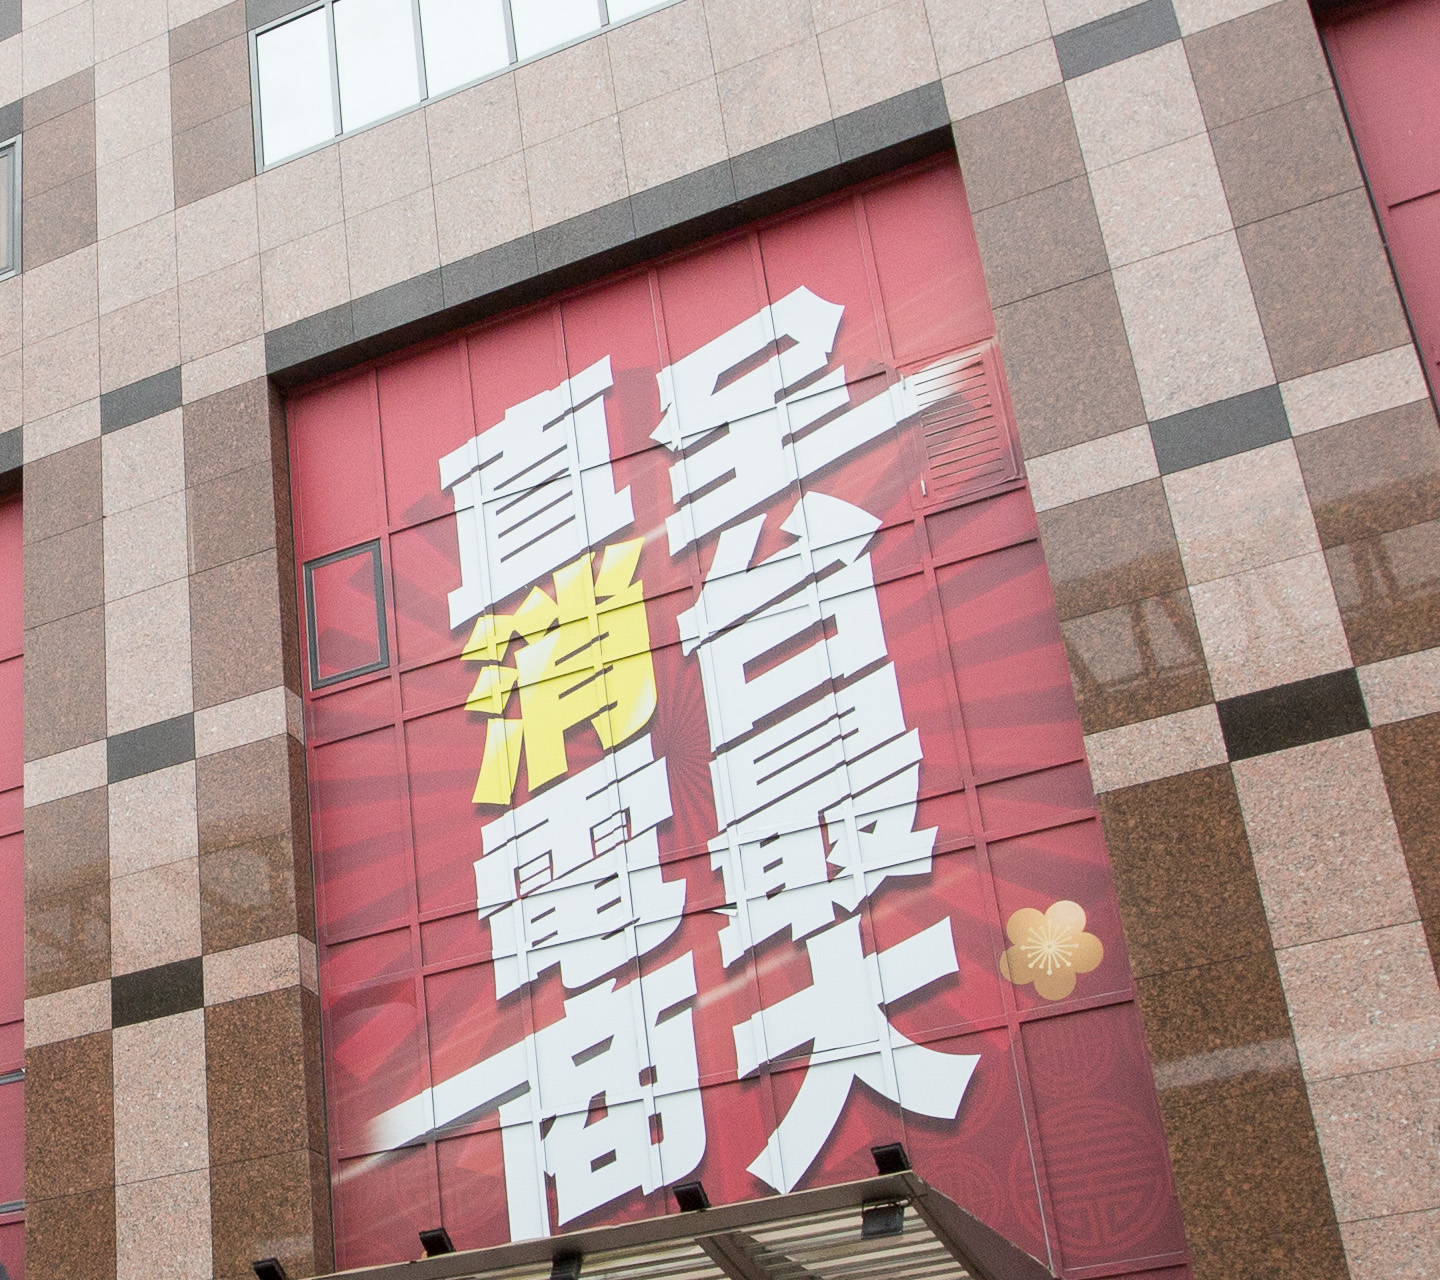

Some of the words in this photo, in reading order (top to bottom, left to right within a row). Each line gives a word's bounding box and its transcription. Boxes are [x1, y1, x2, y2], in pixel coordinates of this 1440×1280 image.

[365, 354, 710, 1241] 直消電商
[650, 285, 988, 1195] 全台最大
